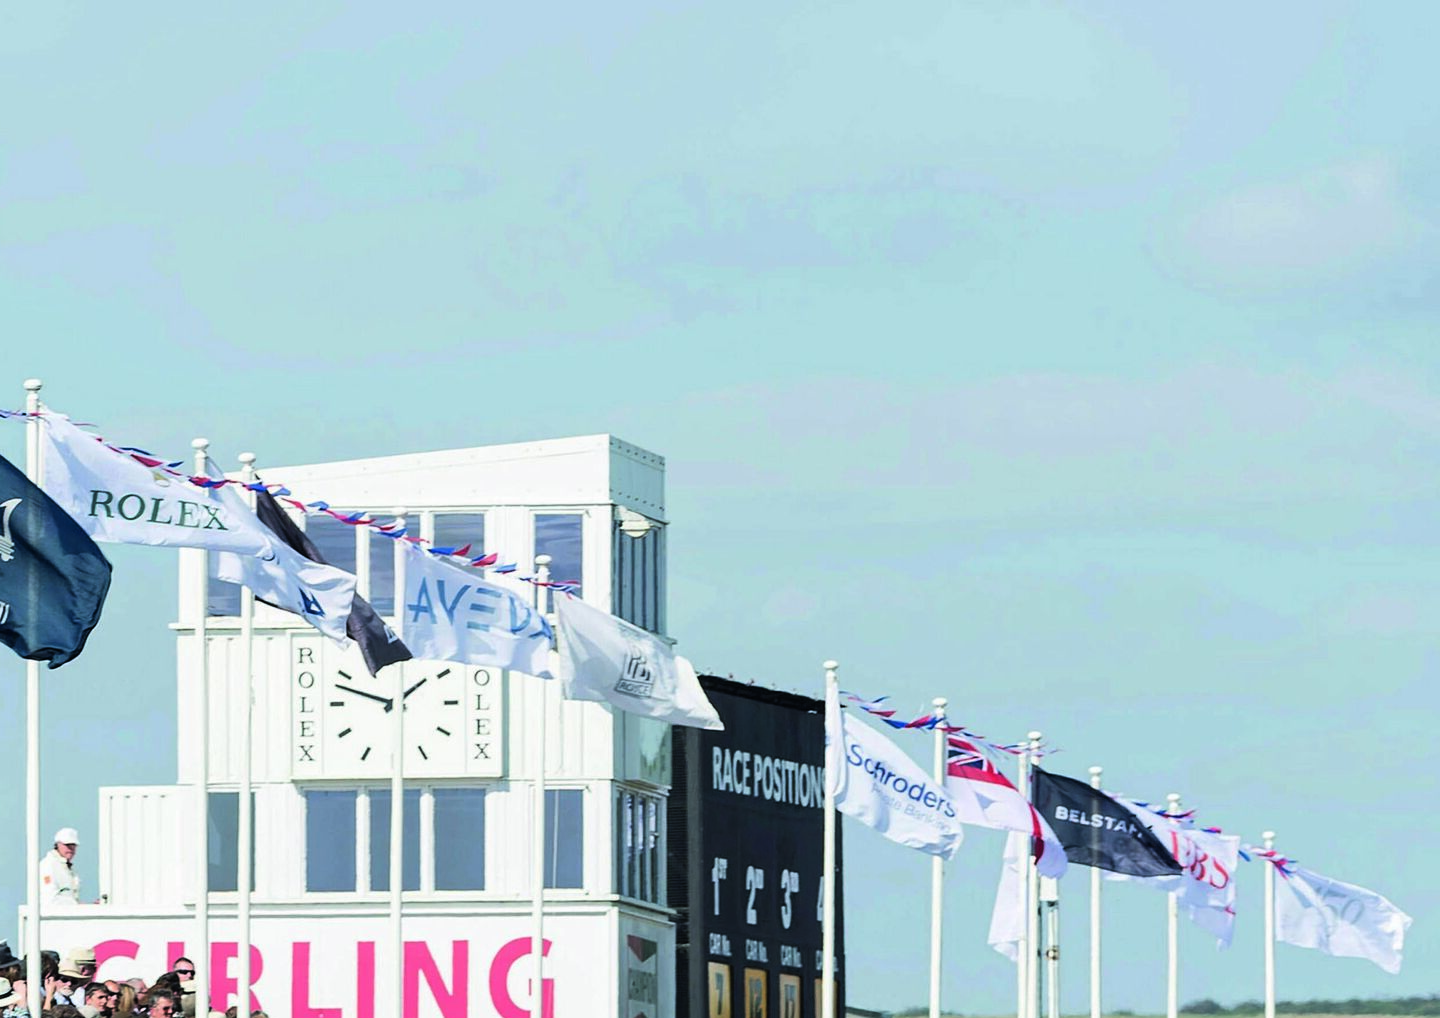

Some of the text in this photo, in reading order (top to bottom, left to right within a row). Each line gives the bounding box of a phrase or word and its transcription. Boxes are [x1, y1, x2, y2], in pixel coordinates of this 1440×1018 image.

[88, 490, 229, 531] ROLEX
[298, 647, 315, 762] ROLEX
[473, 669, 491, 759] OLEX
[712, 746, 751, 796] RACE
[846, 743, 956, 818] Schroders
